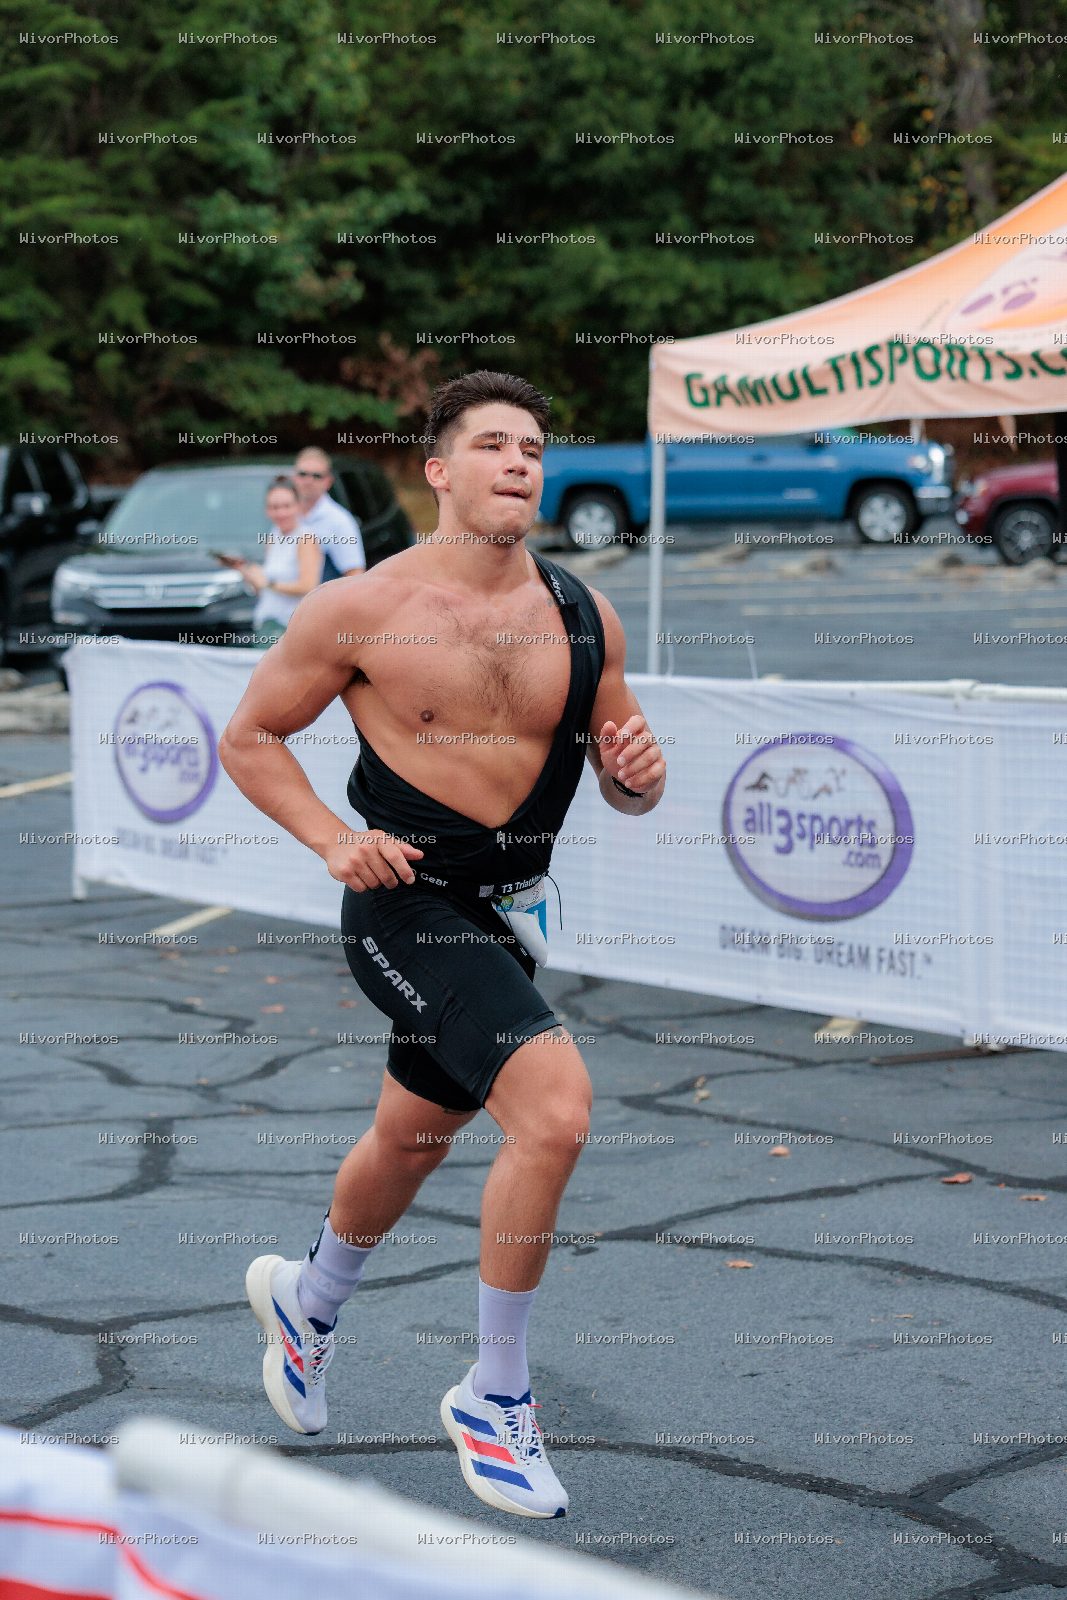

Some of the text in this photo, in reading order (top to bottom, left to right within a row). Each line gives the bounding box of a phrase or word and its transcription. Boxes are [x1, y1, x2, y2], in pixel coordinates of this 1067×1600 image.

[684, 338, 1067, 409] GAMULTISPORTS.C
[420, 872, 449, 887] Gear
[501, 883, 513, 894] T3
[362, 936, 428, 1014] SPARX
